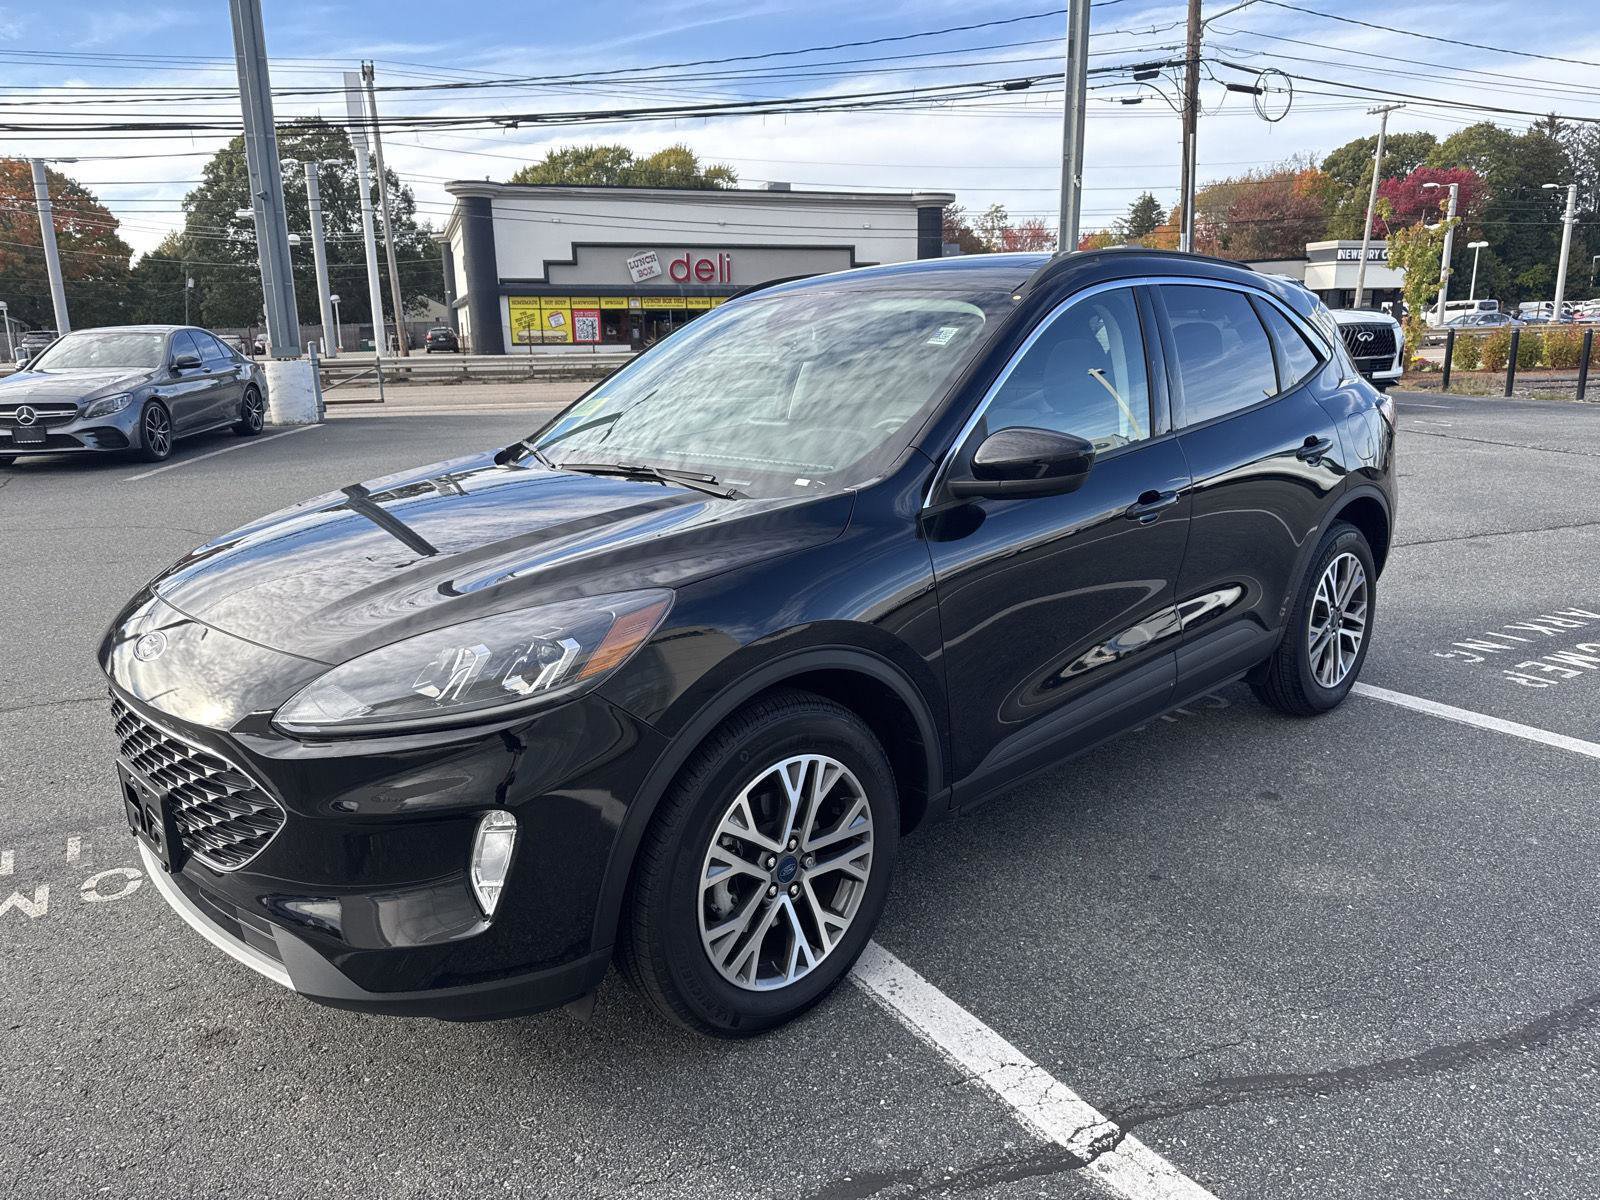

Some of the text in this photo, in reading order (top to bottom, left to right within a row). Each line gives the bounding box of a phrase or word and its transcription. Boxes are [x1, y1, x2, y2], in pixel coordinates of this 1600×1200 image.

[628, 253, 658, 269] LUNCH
[1337, 249, 1380, 260] NEWBRY
[637, 265, 655, 278] BOX
[668, 252, 732, 284] deli
[1433, 607, 1600, 663] ARKING
